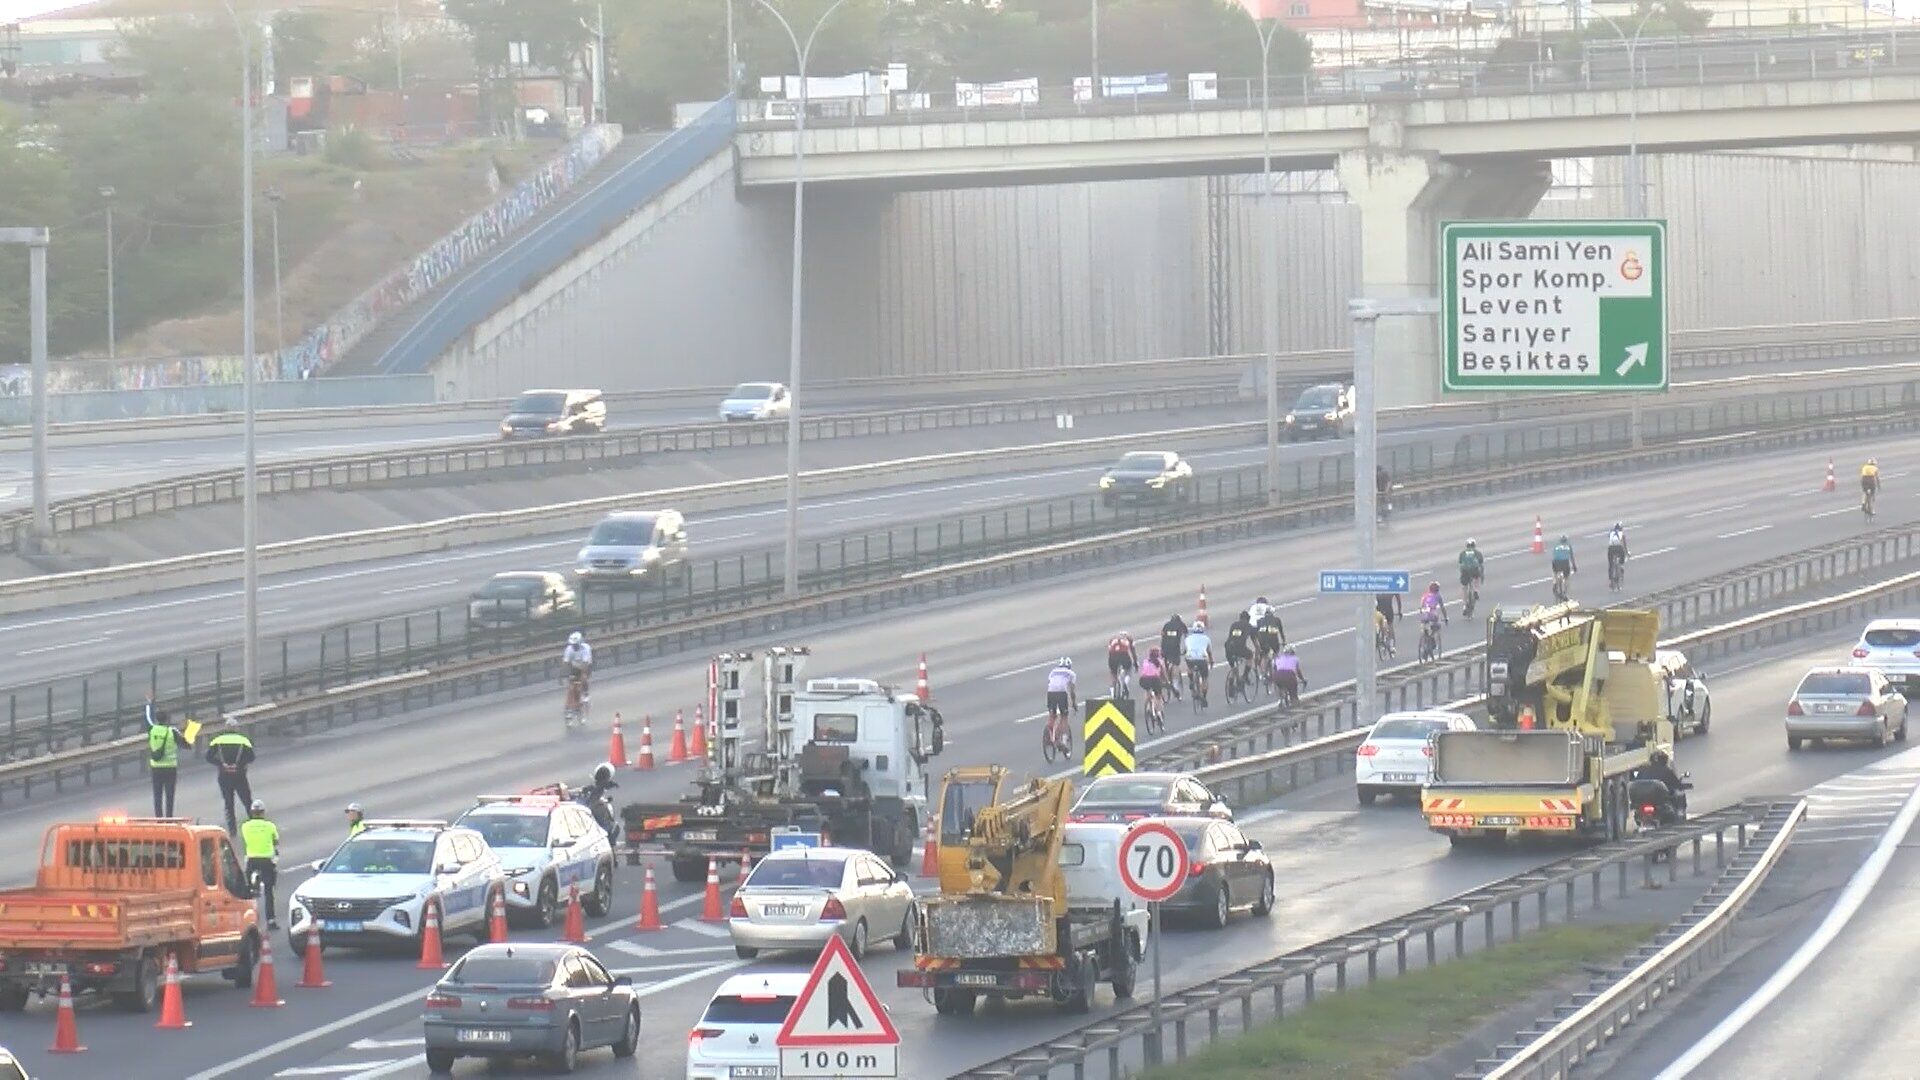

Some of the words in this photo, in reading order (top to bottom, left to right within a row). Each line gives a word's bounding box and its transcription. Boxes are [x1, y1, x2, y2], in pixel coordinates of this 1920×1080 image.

[1462, 242, 1492, 261] Ali
[1499, 241, 1560, 261] Sami
[1565, 241, 1612, 261] Yen
[1462, 269, 1523, 293] Spor
[1533, 269, 1612, 292] Komp.
[1462, 295, 1562, 315] Levent
[1463, 324, 1571, 347] Sarıyer
[1462, 351, 1589, 372] Beşiktaş
[1134, 845, 1174, 878] 70
